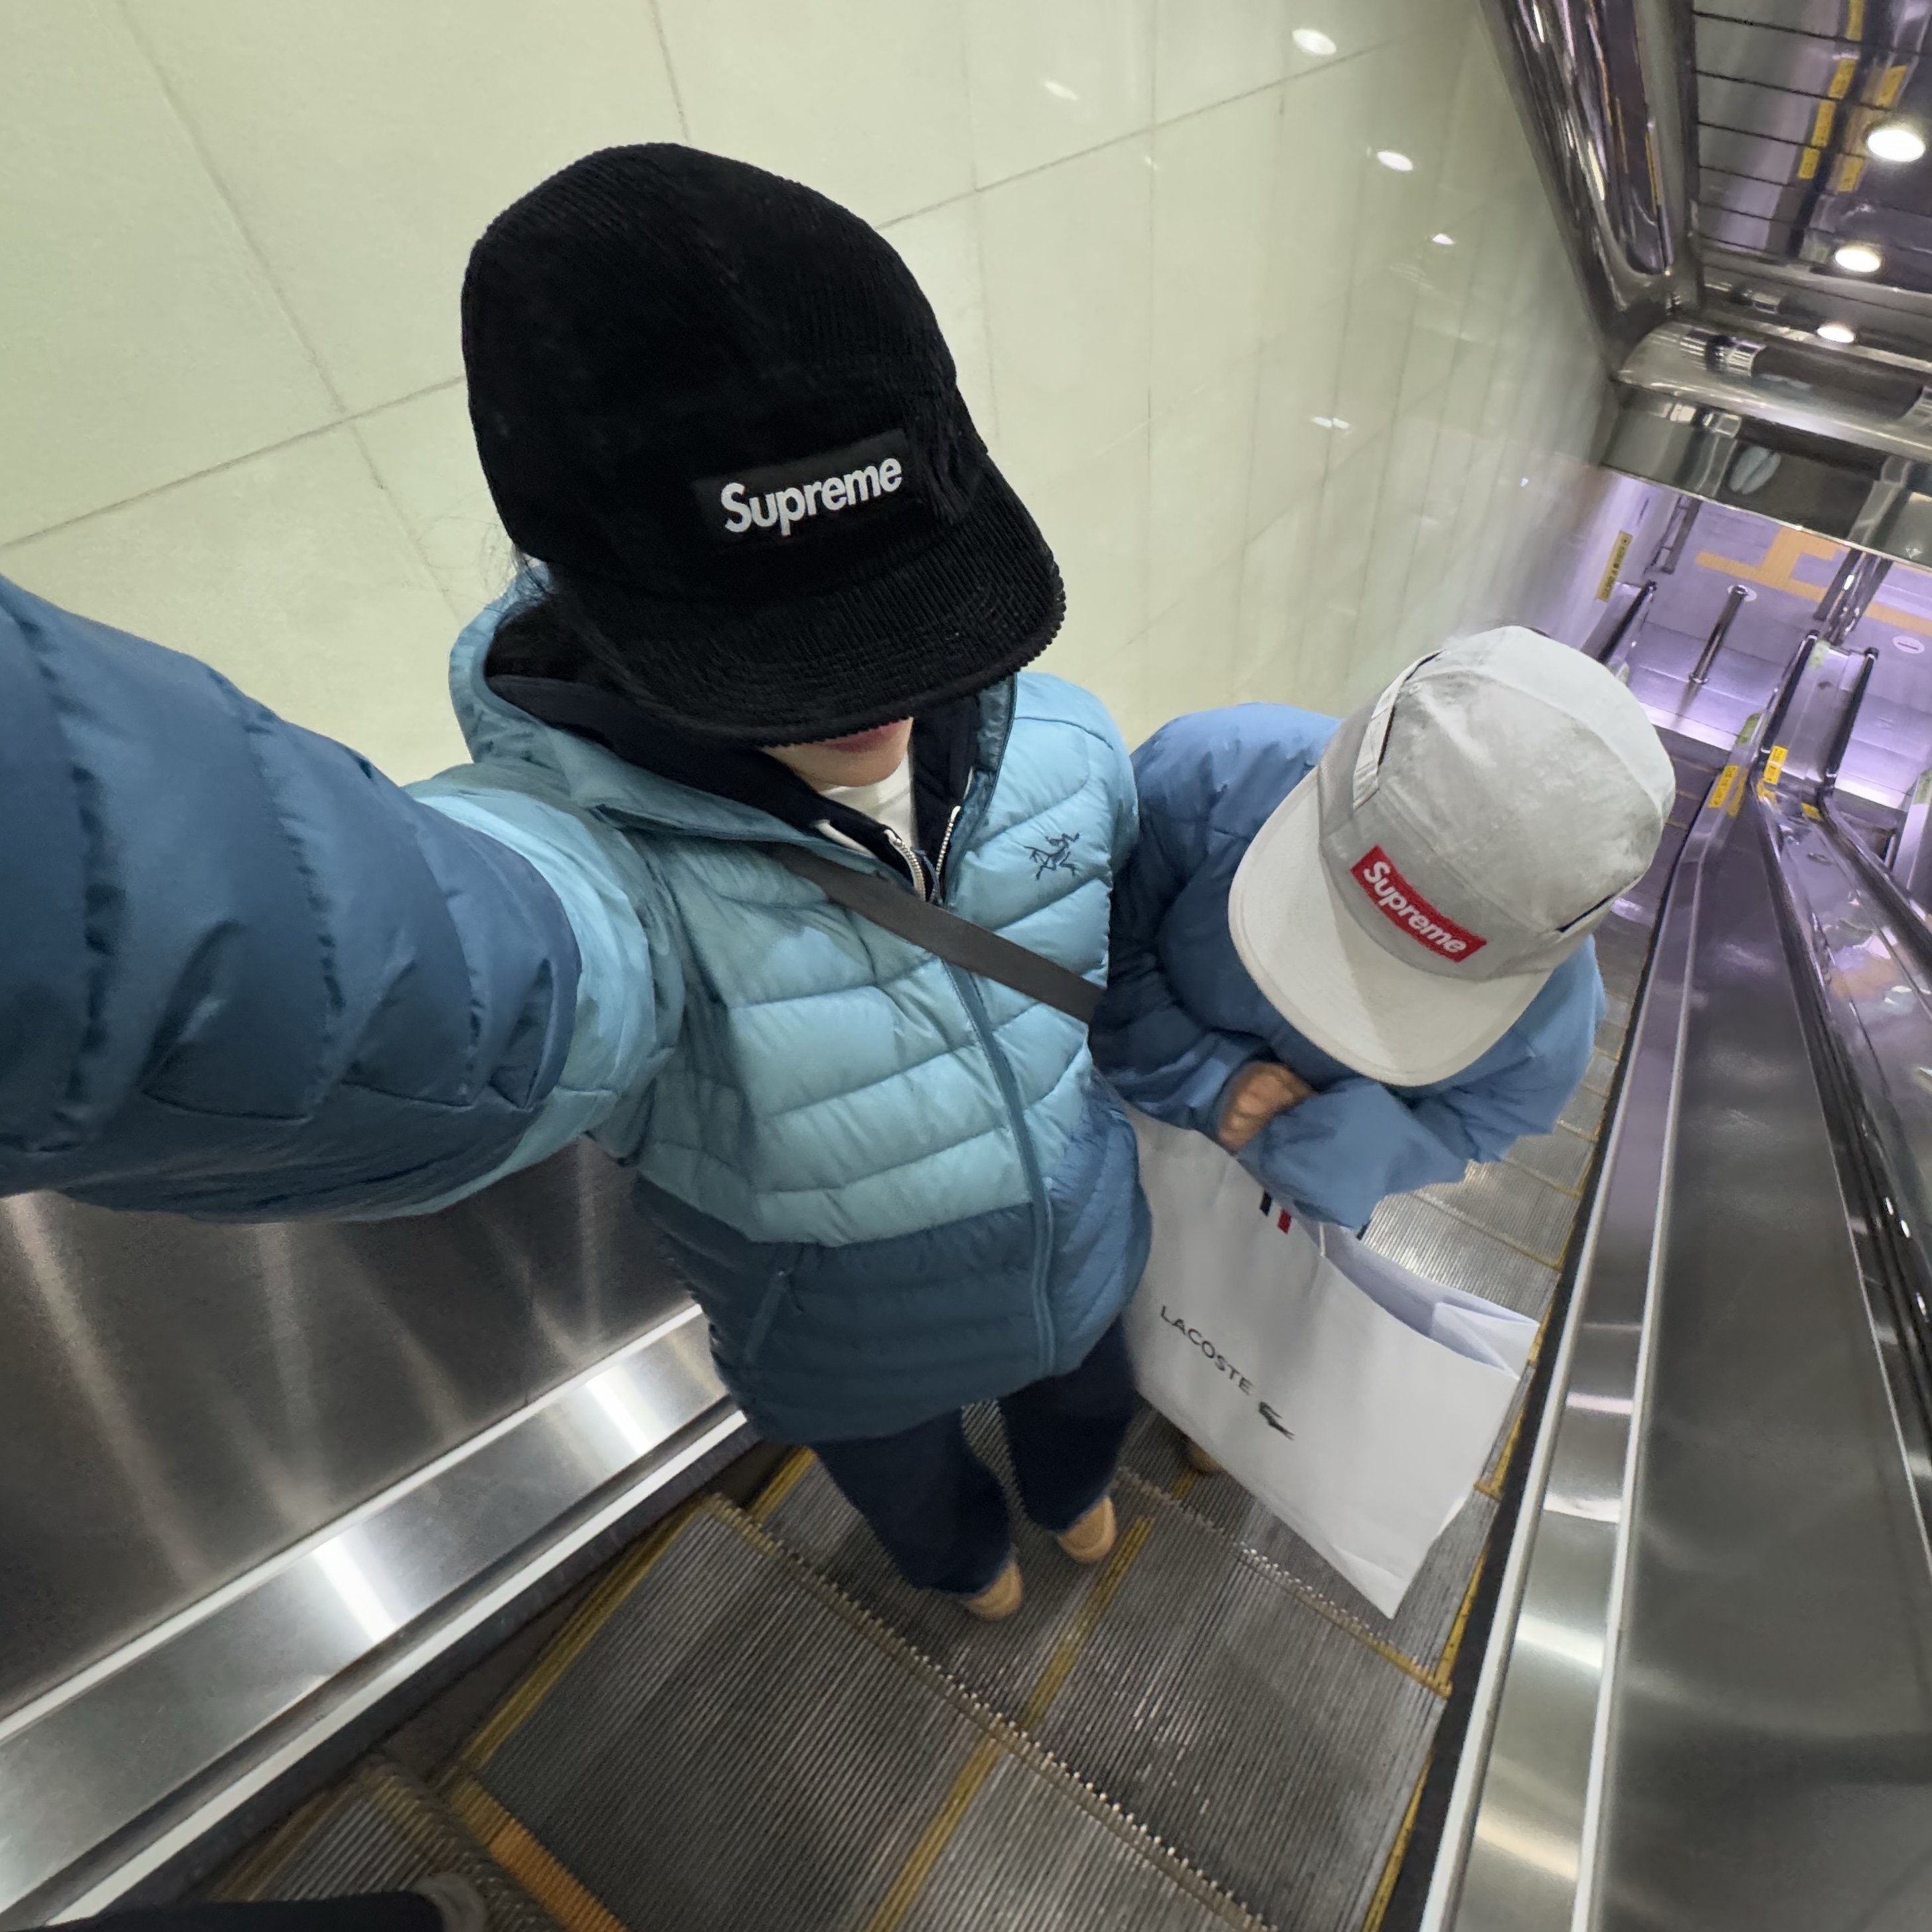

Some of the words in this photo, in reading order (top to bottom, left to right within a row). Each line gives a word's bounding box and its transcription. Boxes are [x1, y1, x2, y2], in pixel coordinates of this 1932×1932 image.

[720, 457, 903, 536] Supreme
[1363, 860, 1467, 953] Supreme
[1160, 1305, 1255, 1396] LACOSTE
